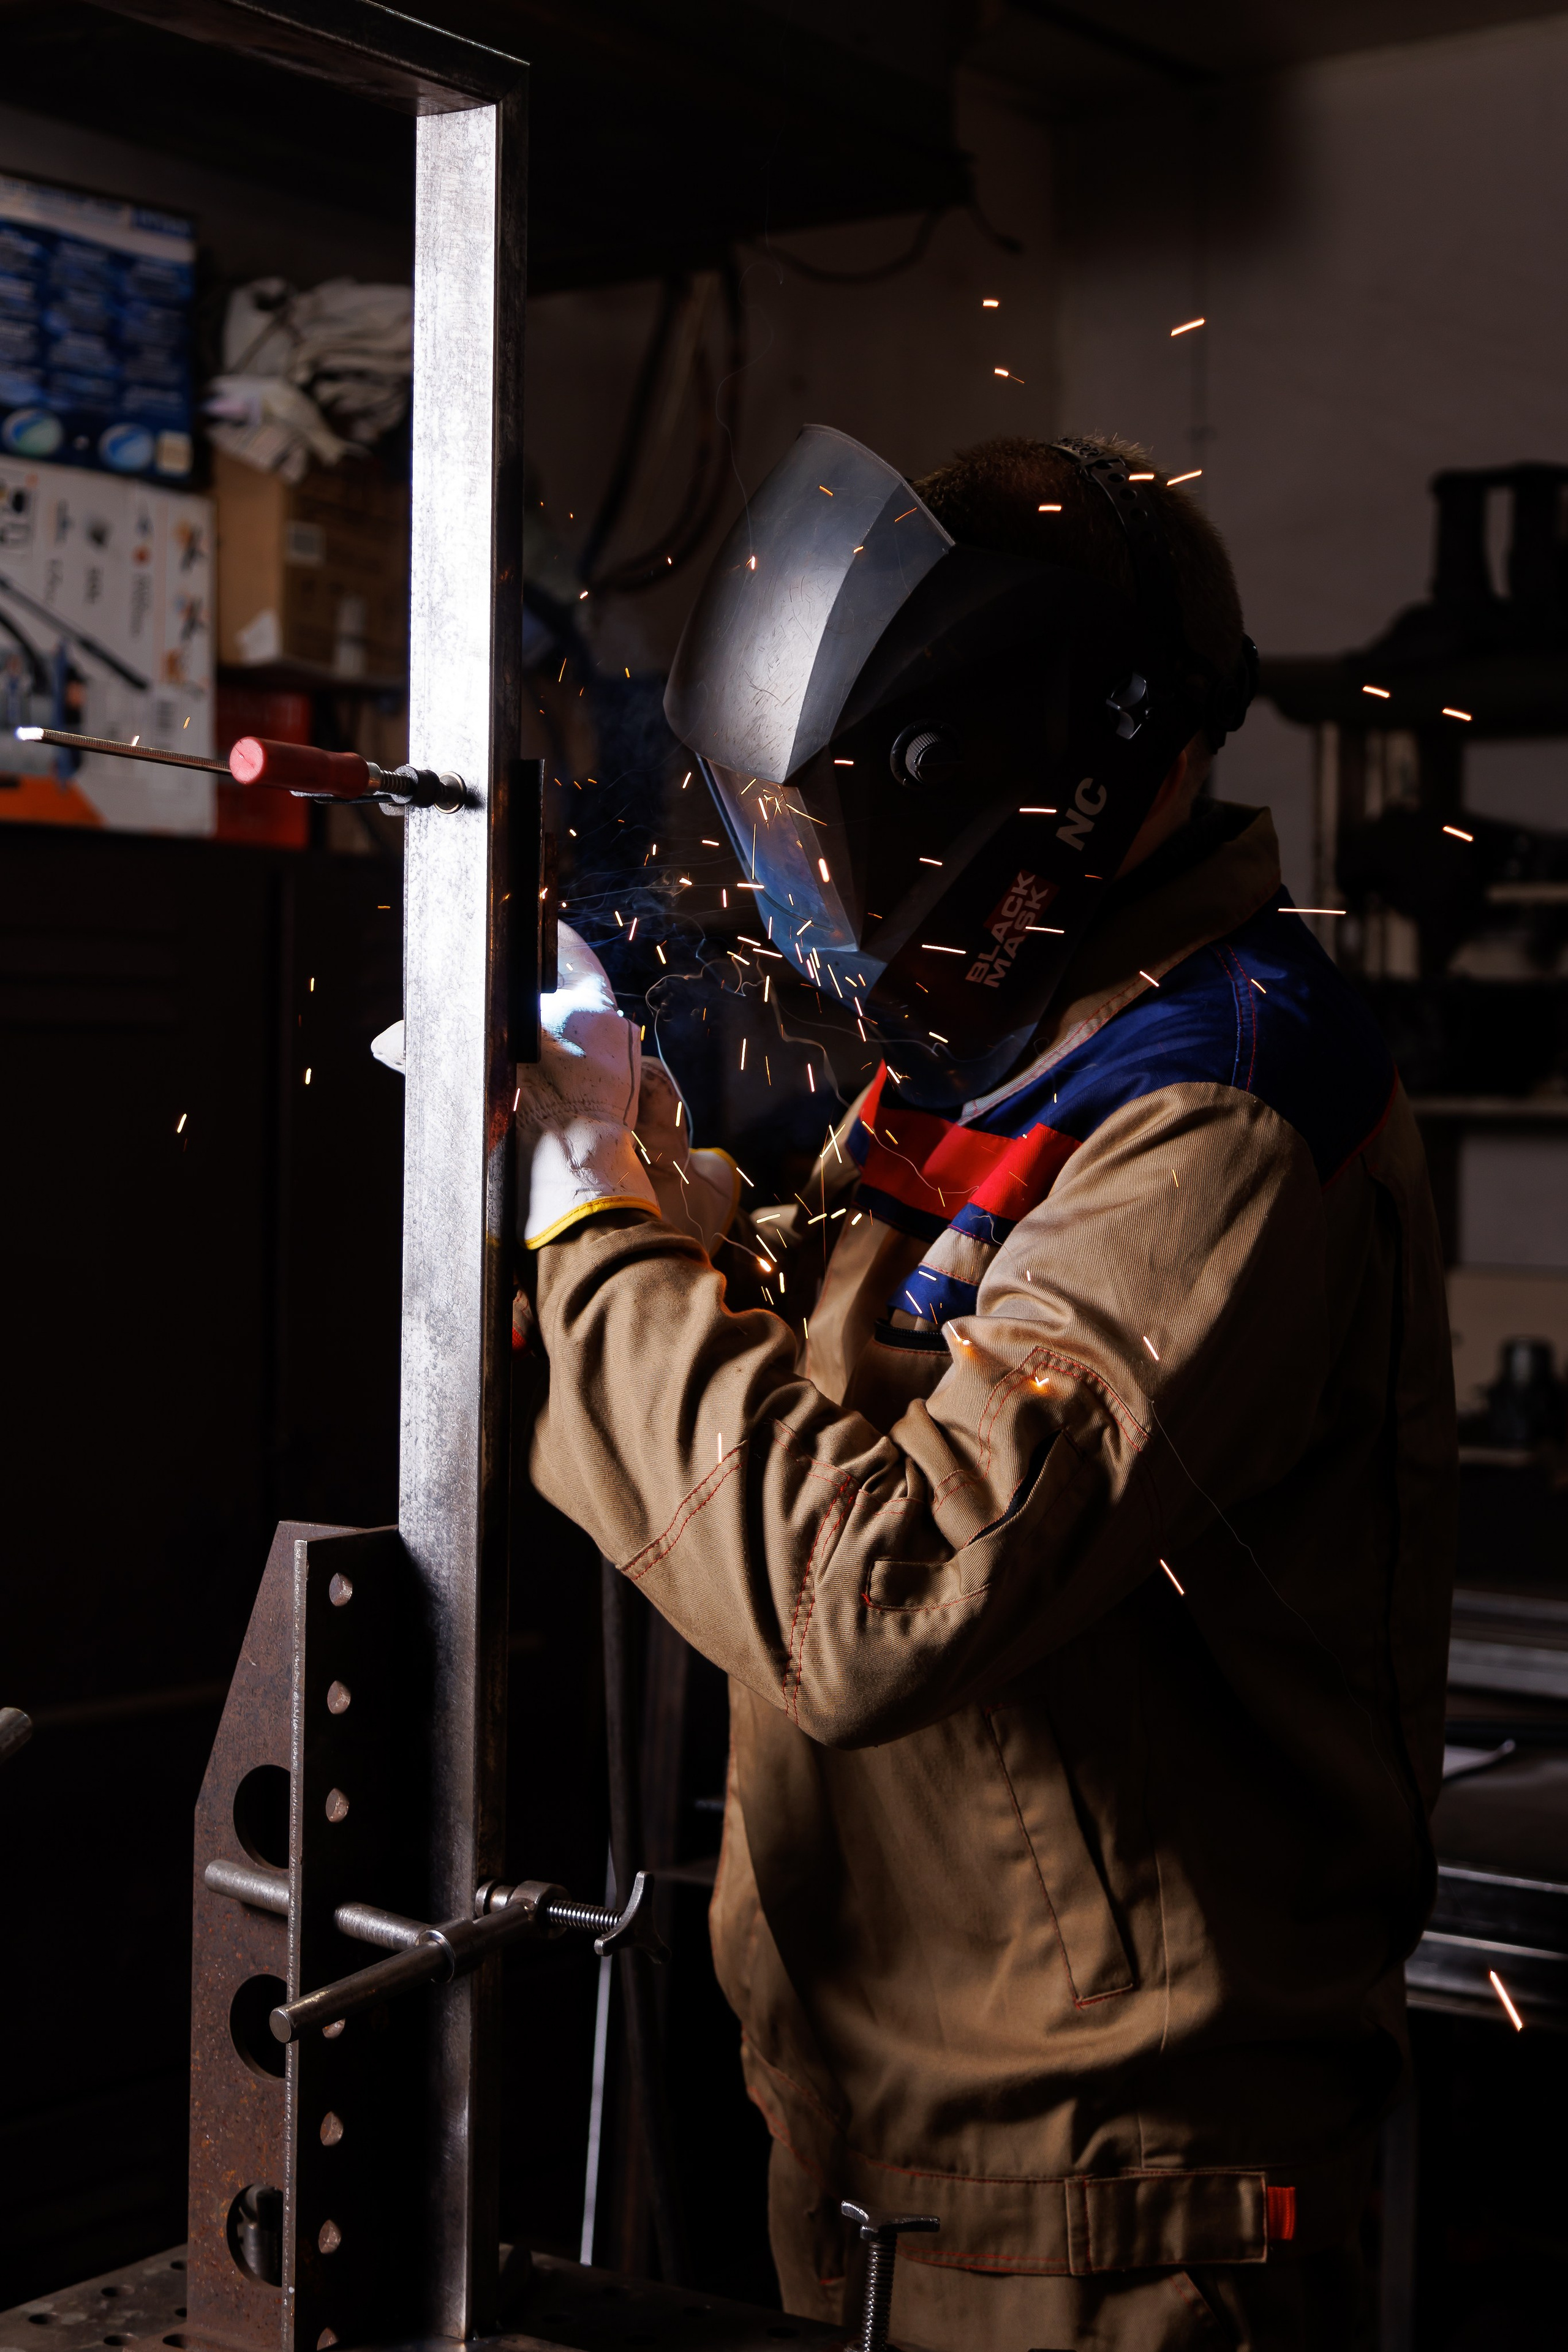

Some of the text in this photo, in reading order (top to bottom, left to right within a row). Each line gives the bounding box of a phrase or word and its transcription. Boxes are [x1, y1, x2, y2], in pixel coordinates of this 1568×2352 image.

[1055, 777, 1107, 851] NC
[964, 872, 1036, 982] BLACK
[984, 886, 1049, 988] MASK
